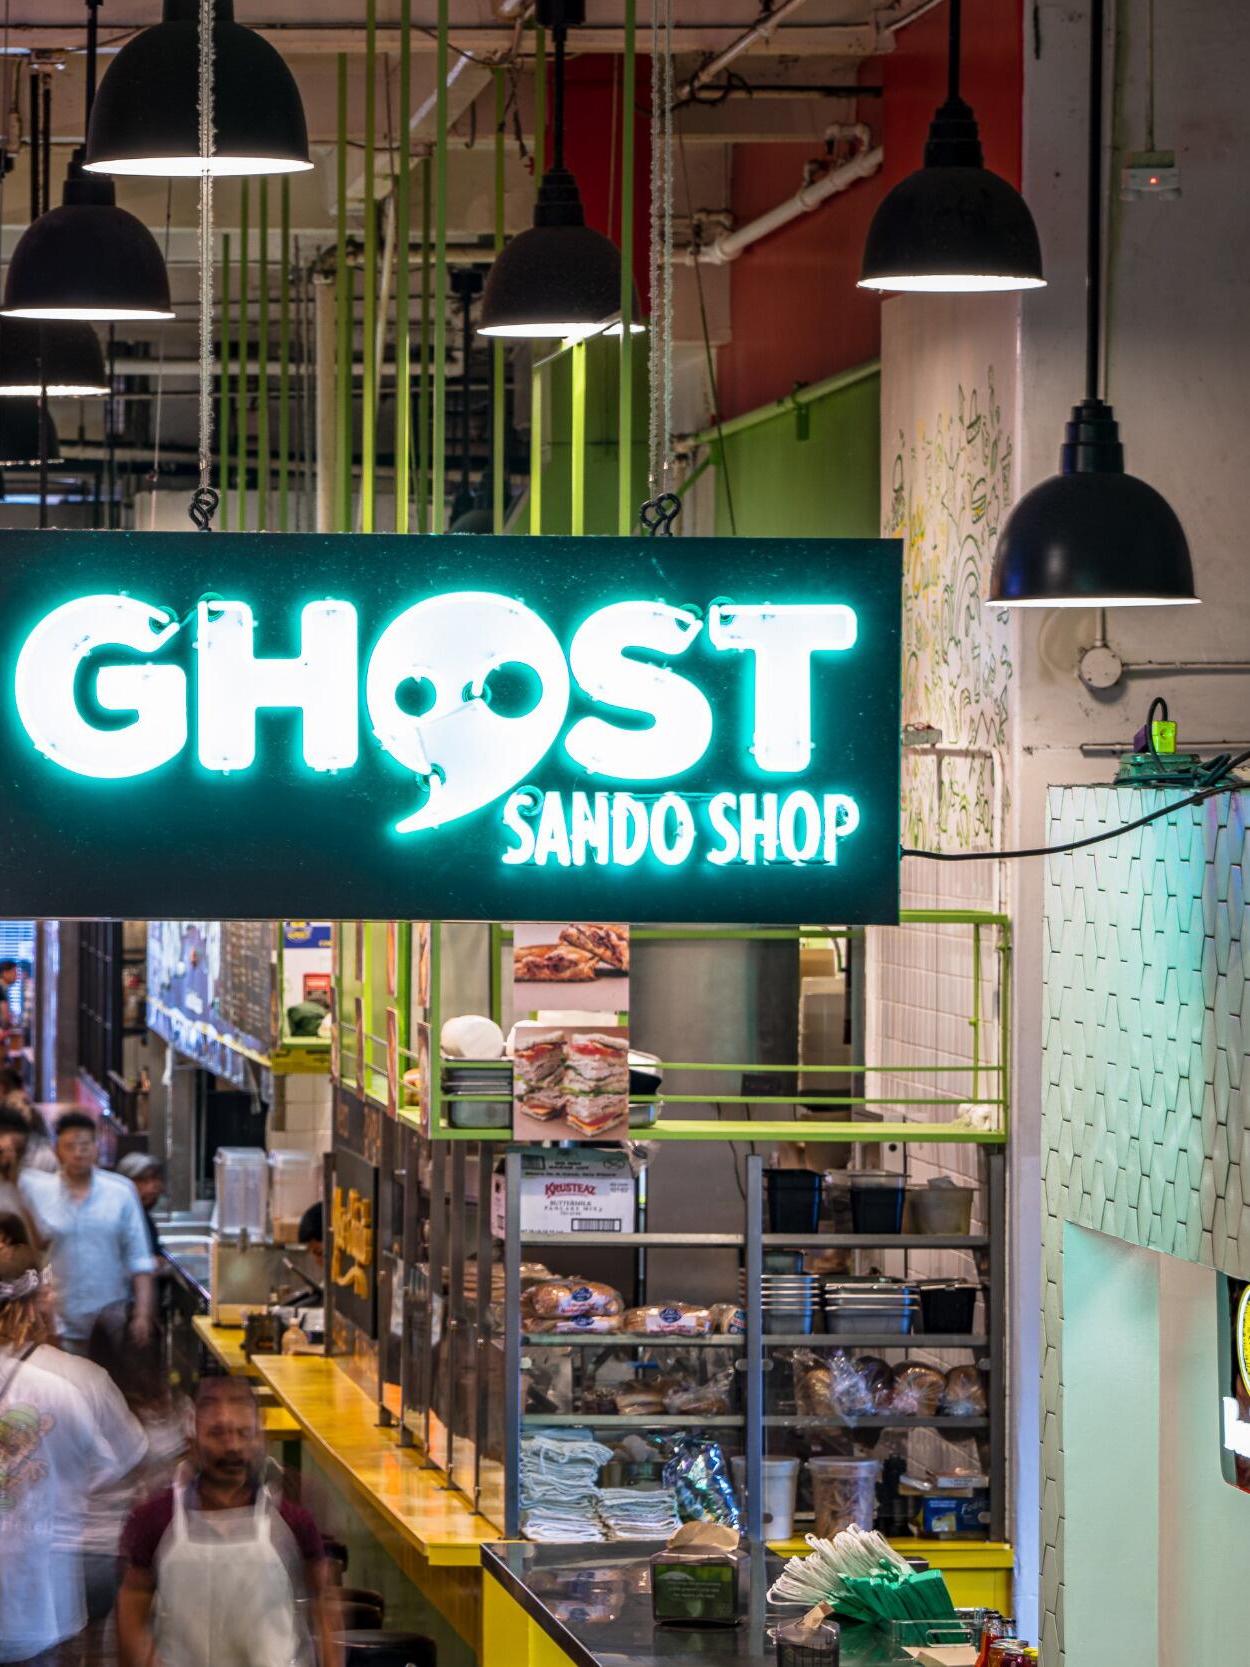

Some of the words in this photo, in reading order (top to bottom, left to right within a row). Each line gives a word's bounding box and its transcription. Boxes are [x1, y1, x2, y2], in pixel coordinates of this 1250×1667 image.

[14, 590, 858, 835] GHOST
[501, 791, 694, 867] SANDO
[708, 791, 861, 867] SHOP
[545, 1182, 598, 1199] KRUSTEAZ
